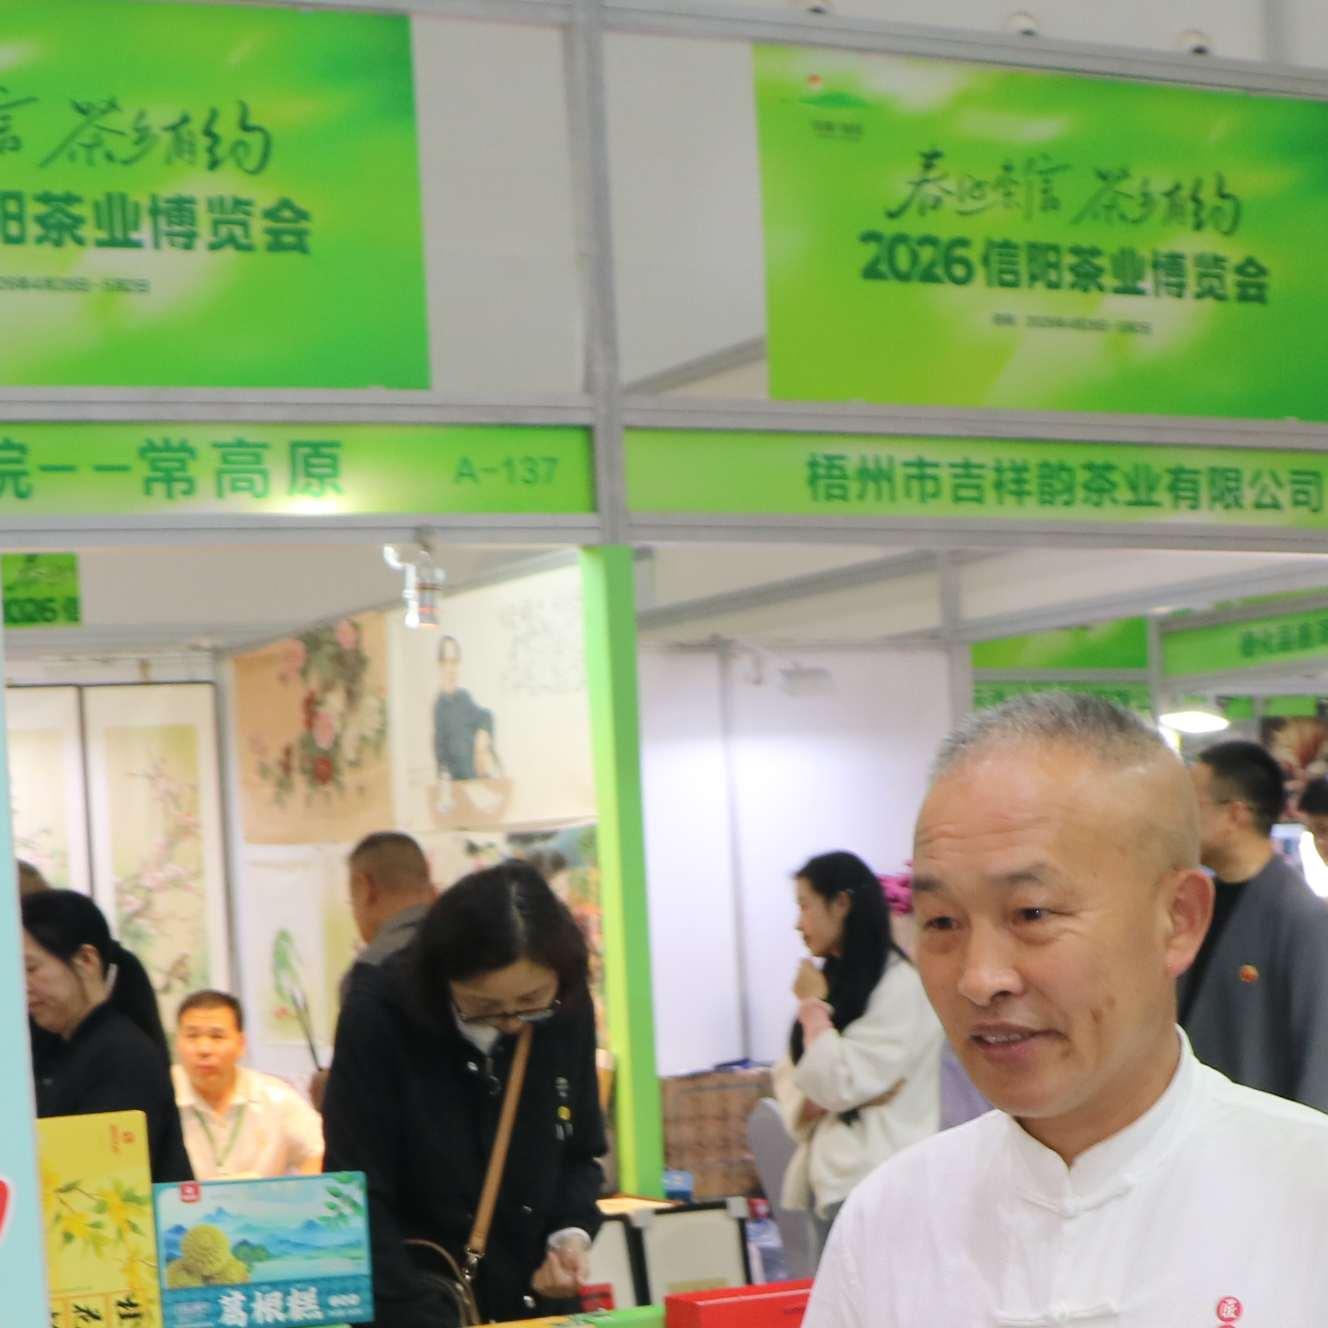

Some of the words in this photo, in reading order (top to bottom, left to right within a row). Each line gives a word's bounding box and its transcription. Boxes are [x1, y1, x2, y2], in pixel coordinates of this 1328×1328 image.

[858, 229, 1270, 306] 2026信阳茶业博览会
[453, 455, 560, 487] A-137
[806, 451, 1325, 515] 梧州市吉祥韵茶业有限公司
